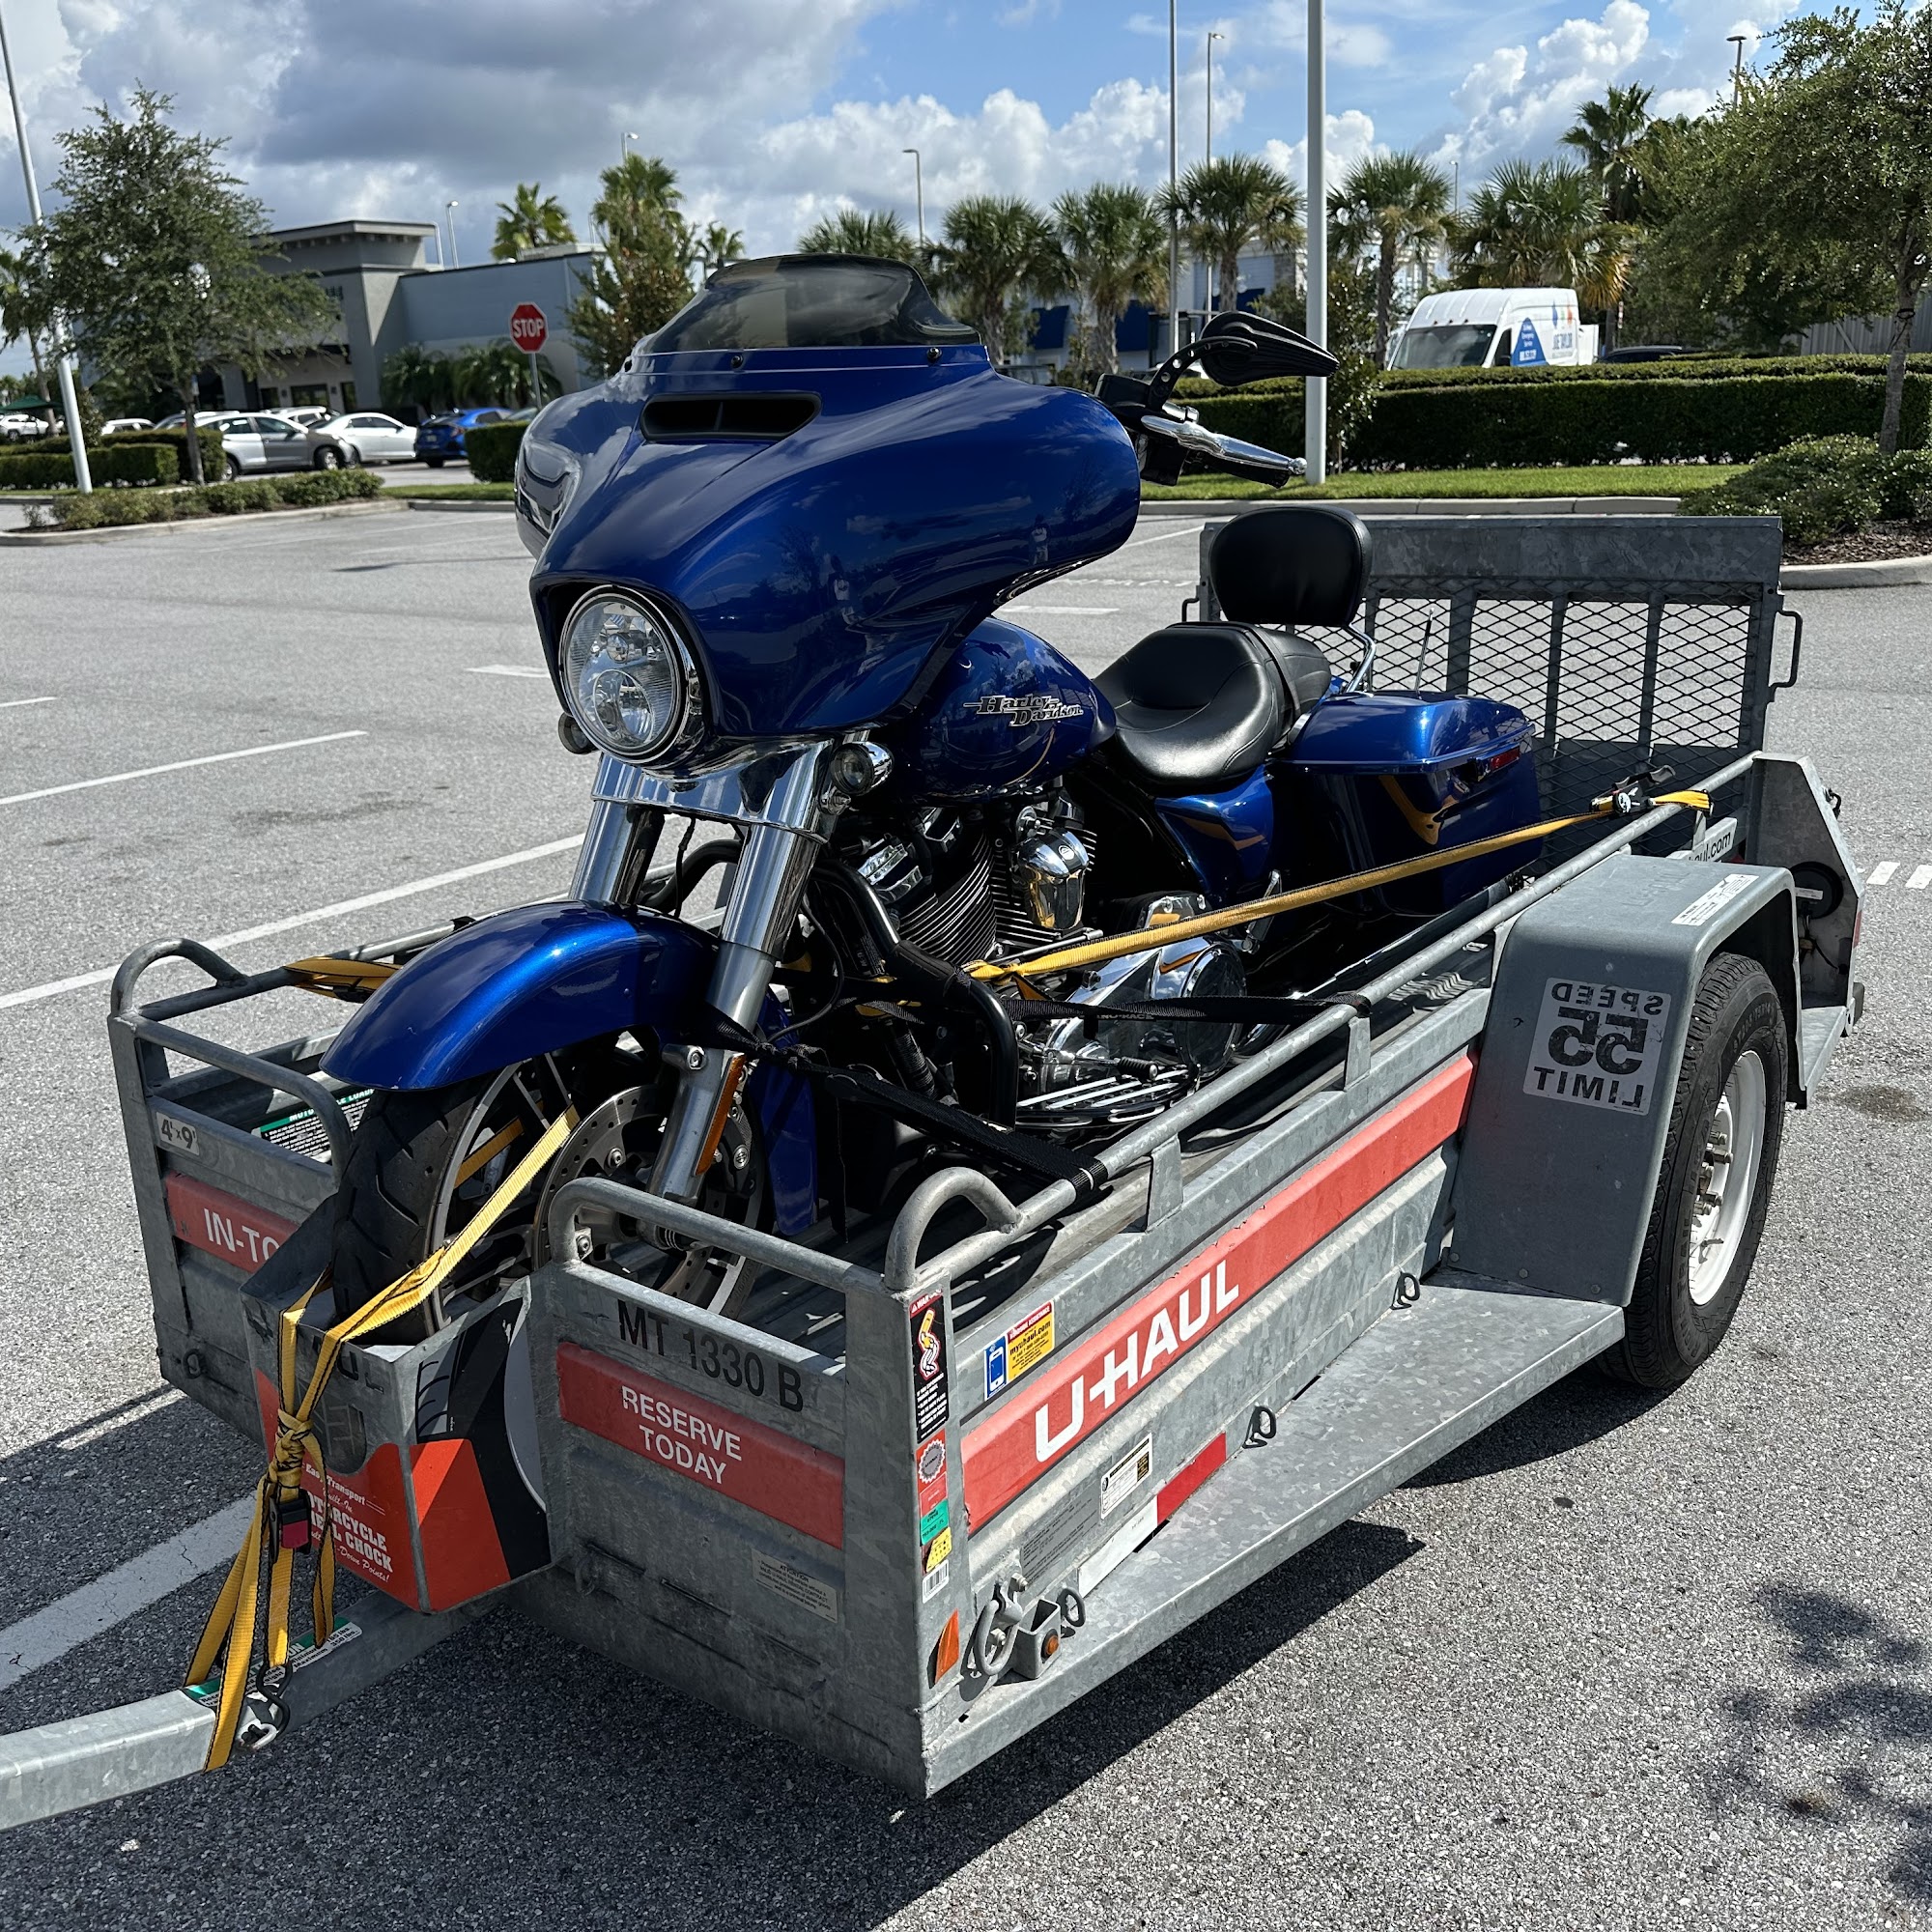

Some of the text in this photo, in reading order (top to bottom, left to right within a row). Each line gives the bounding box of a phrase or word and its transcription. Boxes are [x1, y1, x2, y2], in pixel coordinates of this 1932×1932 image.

[513, 319, 544, 338] STOP
[617, 1299, 804, 1412] MT 1330 B
[1035, 1259, 1239, 1463] U-HAUL
[621, 1385, 742, 1462] RESERVE
[639, 1425, 726, 1485] TODAY
[327, 1475, 366, 1506] Transport
[345, 1531, 393, 1573] CHOCK
[362, 1559, 390, 1583] Points!
